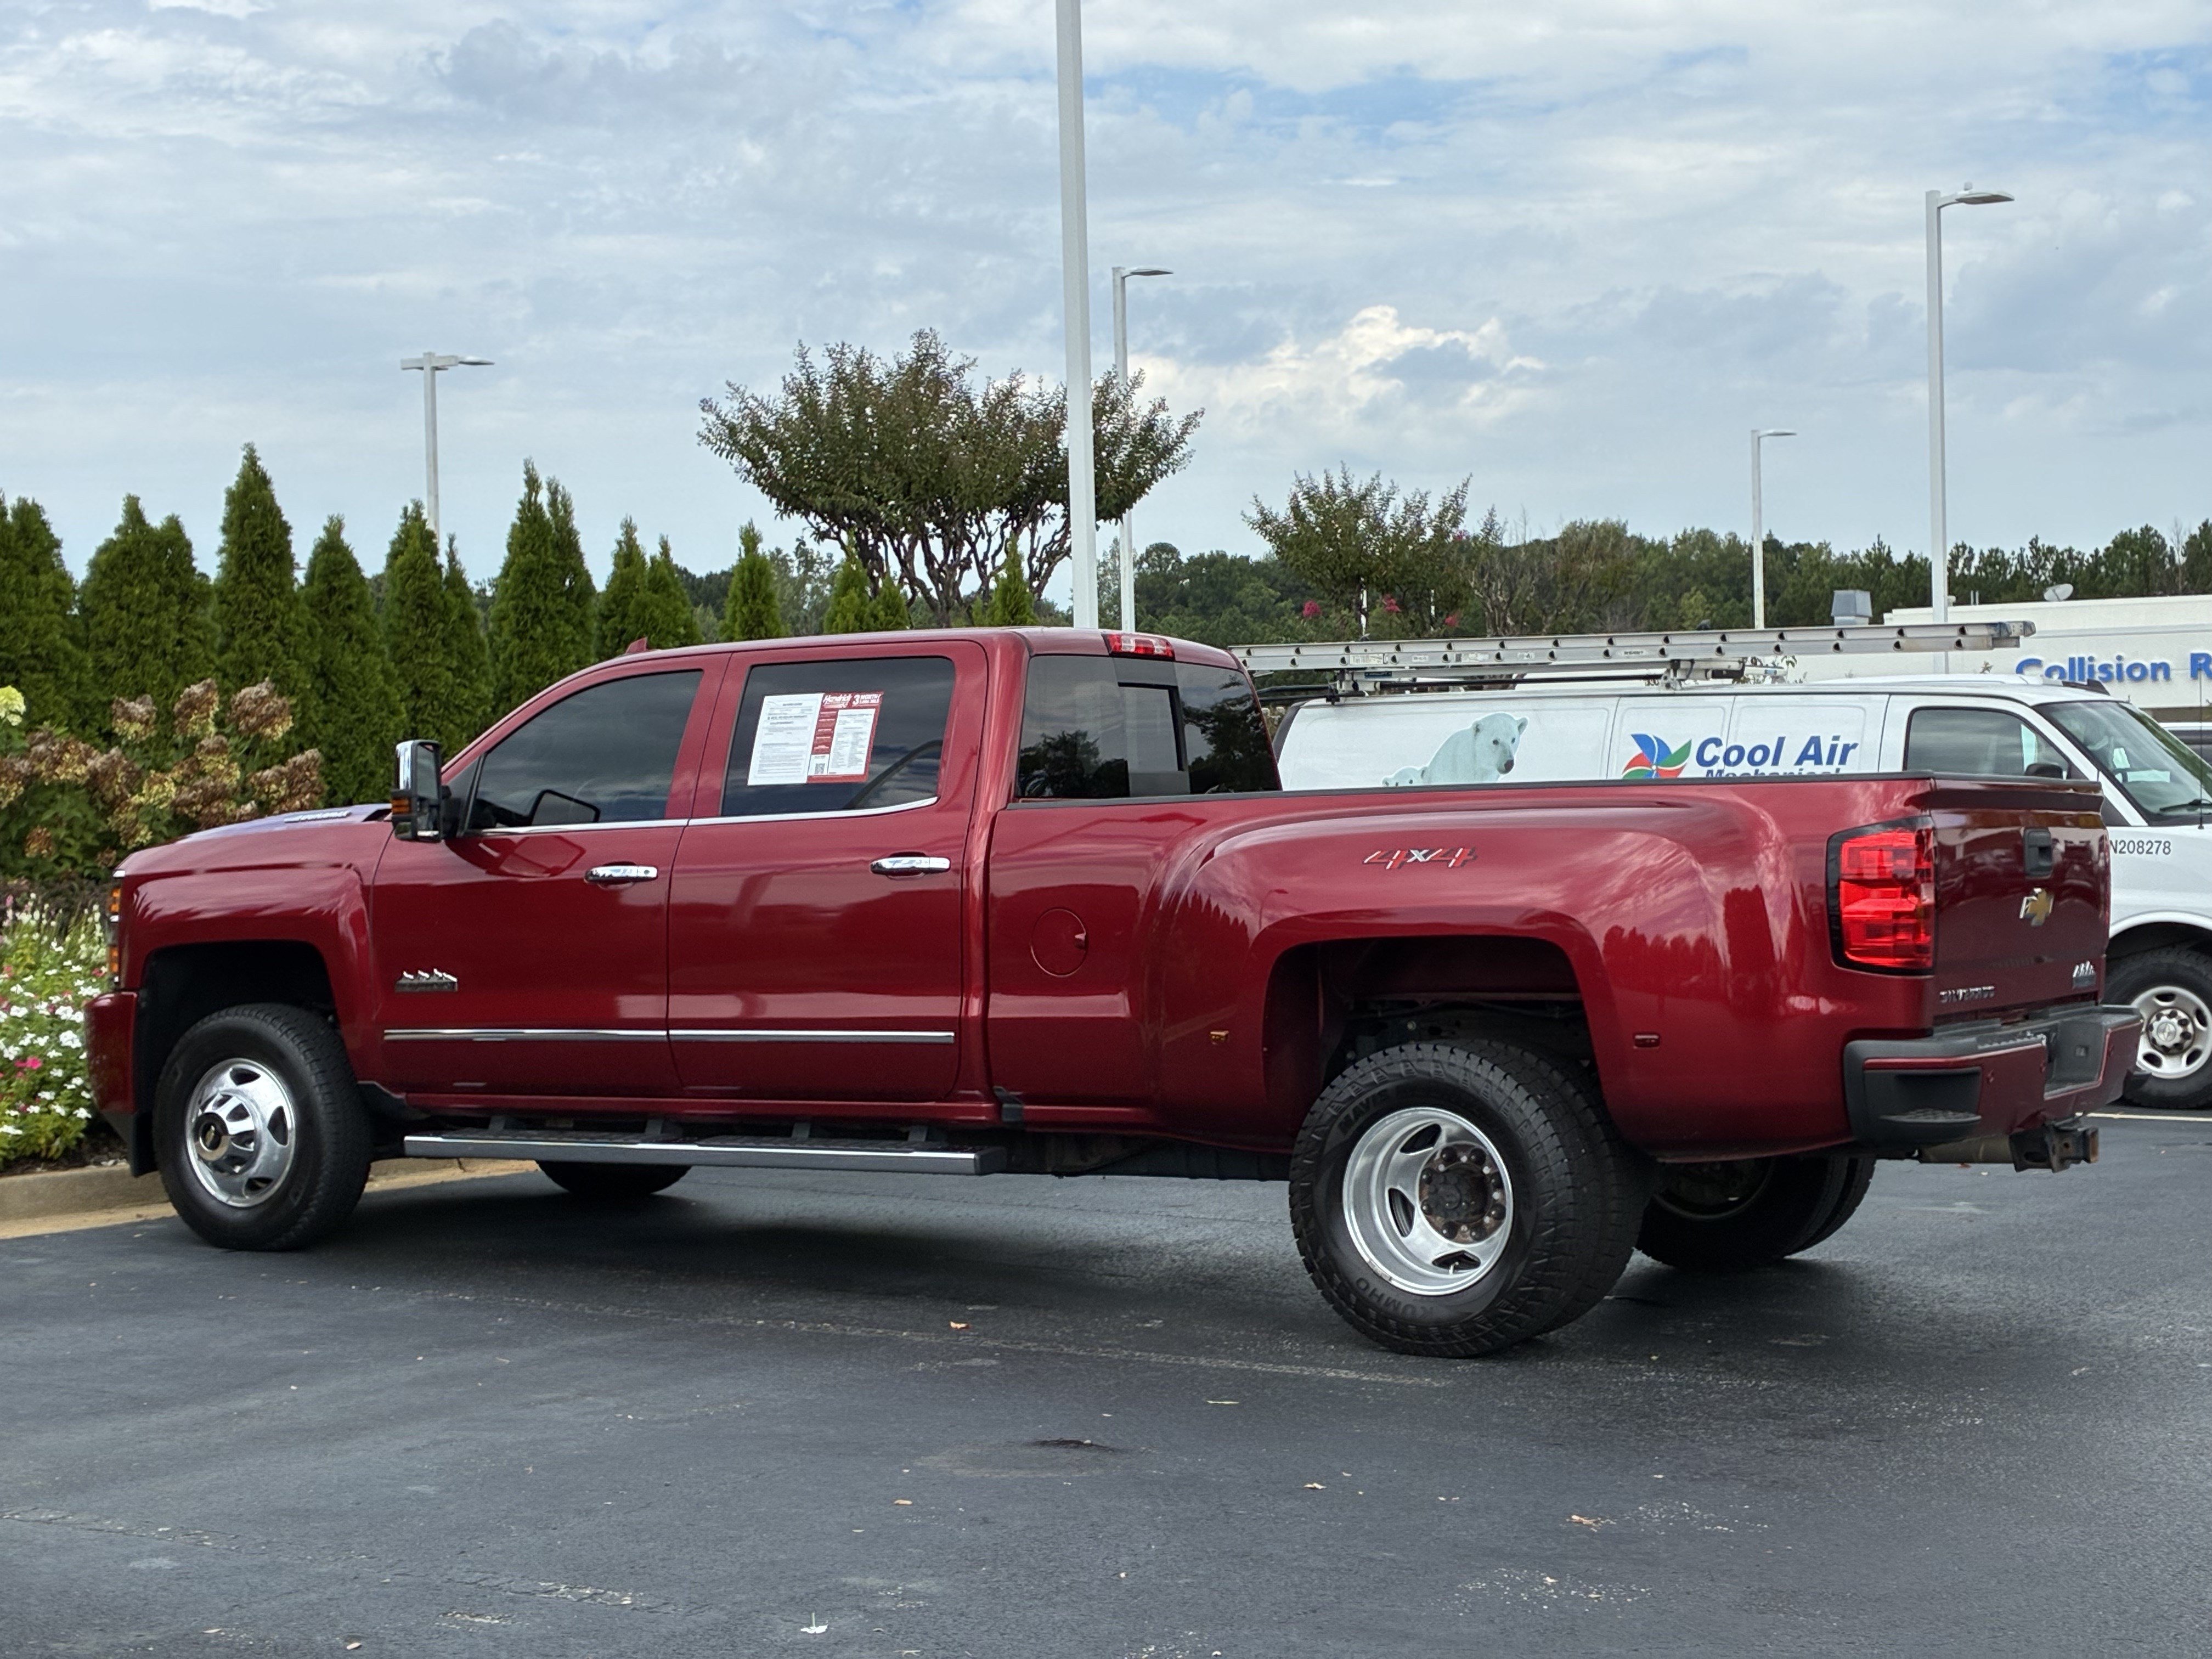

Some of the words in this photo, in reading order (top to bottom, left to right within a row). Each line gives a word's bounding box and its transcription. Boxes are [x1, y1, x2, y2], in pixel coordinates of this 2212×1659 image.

[2015, 654, 2171, 682] Collision
[1696, 736, 1786, 768] Cool
[1794, 735, 1859, 766] Air
